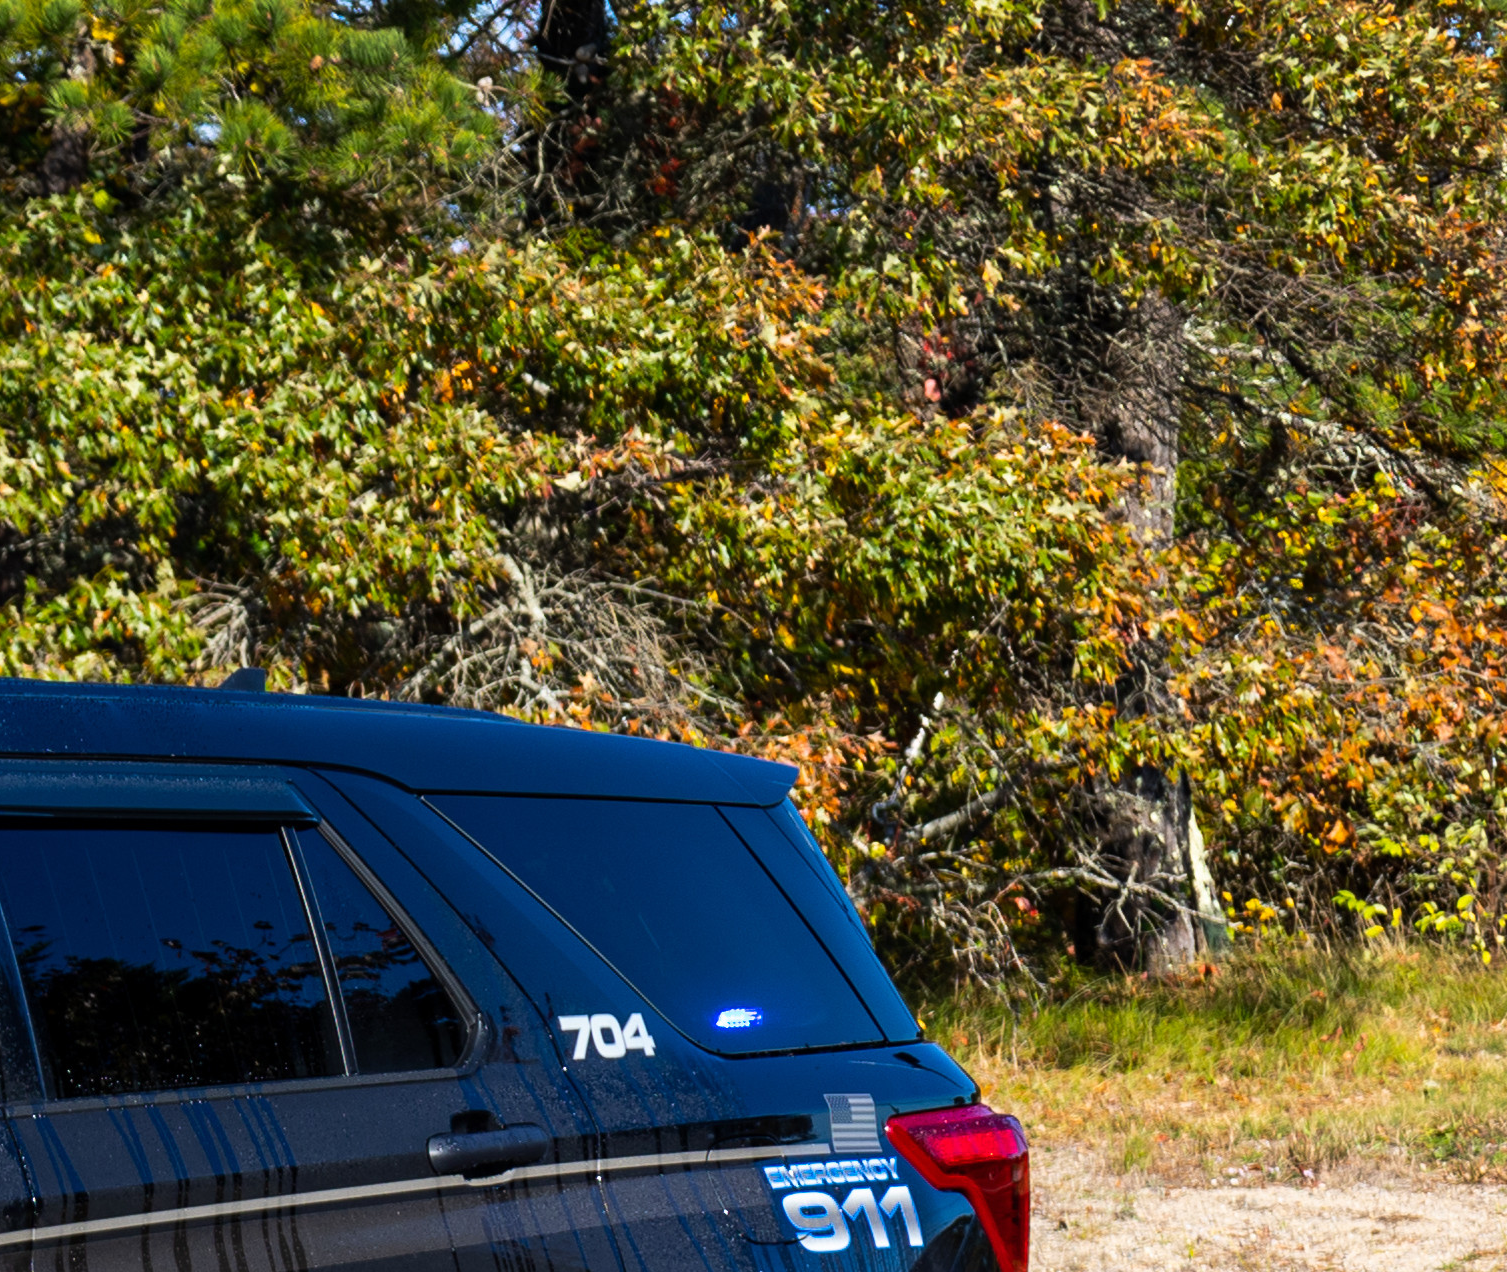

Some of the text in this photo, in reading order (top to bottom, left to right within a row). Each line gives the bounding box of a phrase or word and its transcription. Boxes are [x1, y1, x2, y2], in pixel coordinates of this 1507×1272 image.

[558, 1012, 655, 1060] 704
[763, 1157, 898, 1190] EMERGENCY
[782, 1184, 924, 1253] 911
